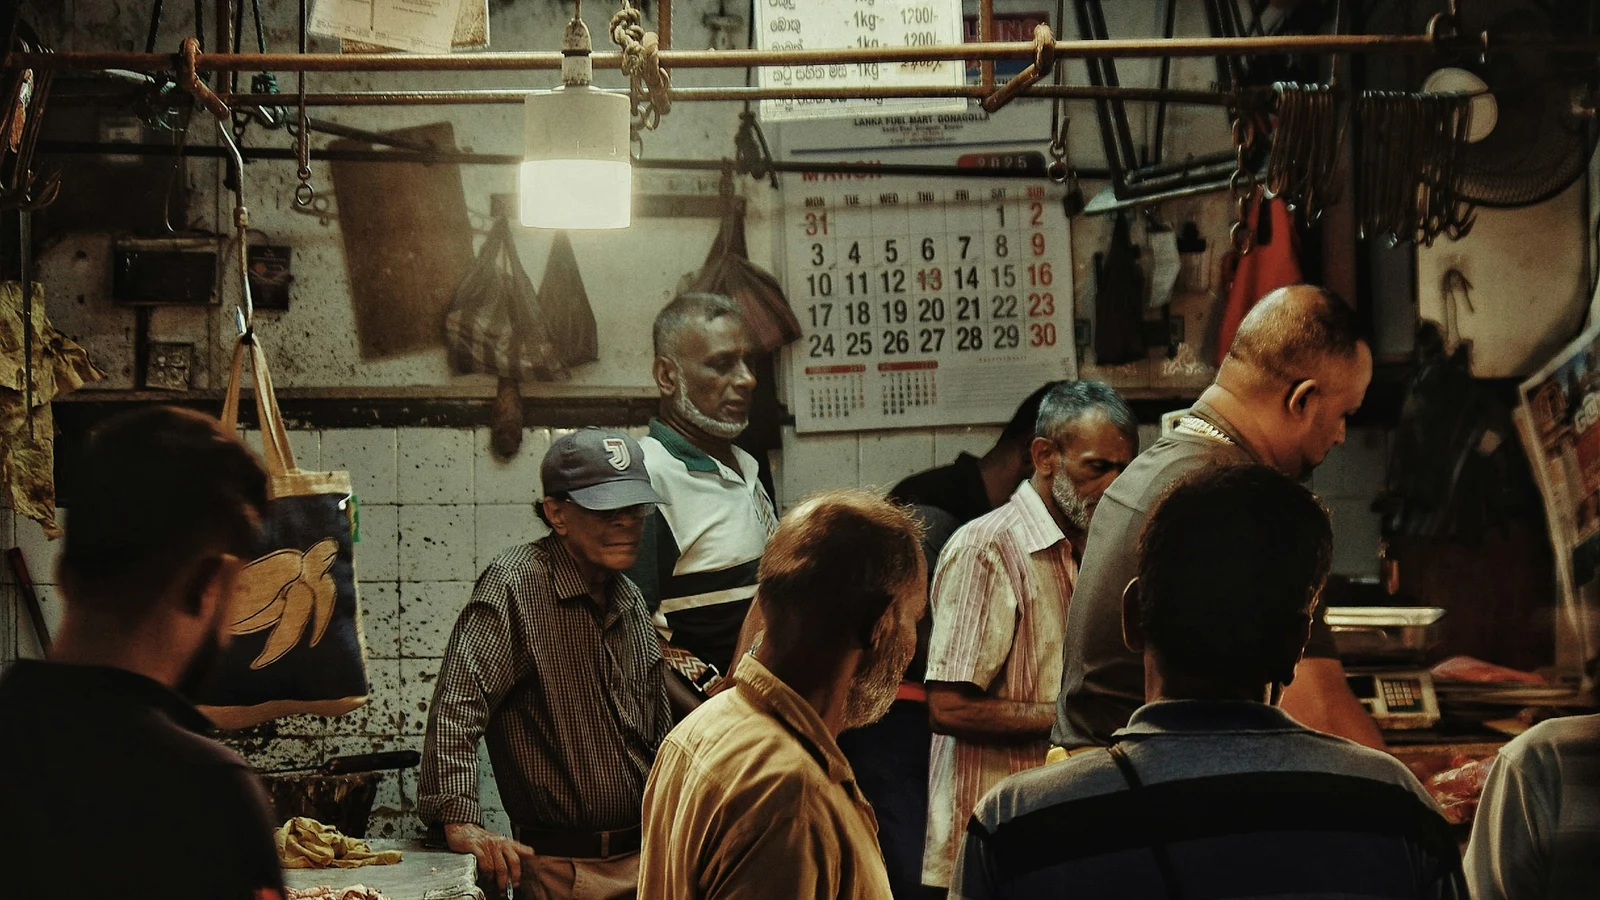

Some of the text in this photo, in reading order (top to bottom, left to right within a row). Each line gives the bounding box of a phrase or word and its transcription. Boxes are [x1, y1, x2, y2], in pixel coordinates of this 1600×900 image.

[854, 116, 883, 127] LANKA
[885, 115, 907, 125] FUEL
[909, 114, 933, 124] MART
[805, 186, 1046, 208] MON TUE WED THU FRI SAT SUN
[805, 202, 1044, 236] 31 1 2
[812, 233, 1045, 266] 3 4 5 6 7 8 9
[807, 263, 1052, 297] 10 11 12 13 14 15 16
[809, 293, 1054, 327] 17 18 19 20 21 22 23
[809, 323, 1056, 357] 24 25 26 27 28 29 30
